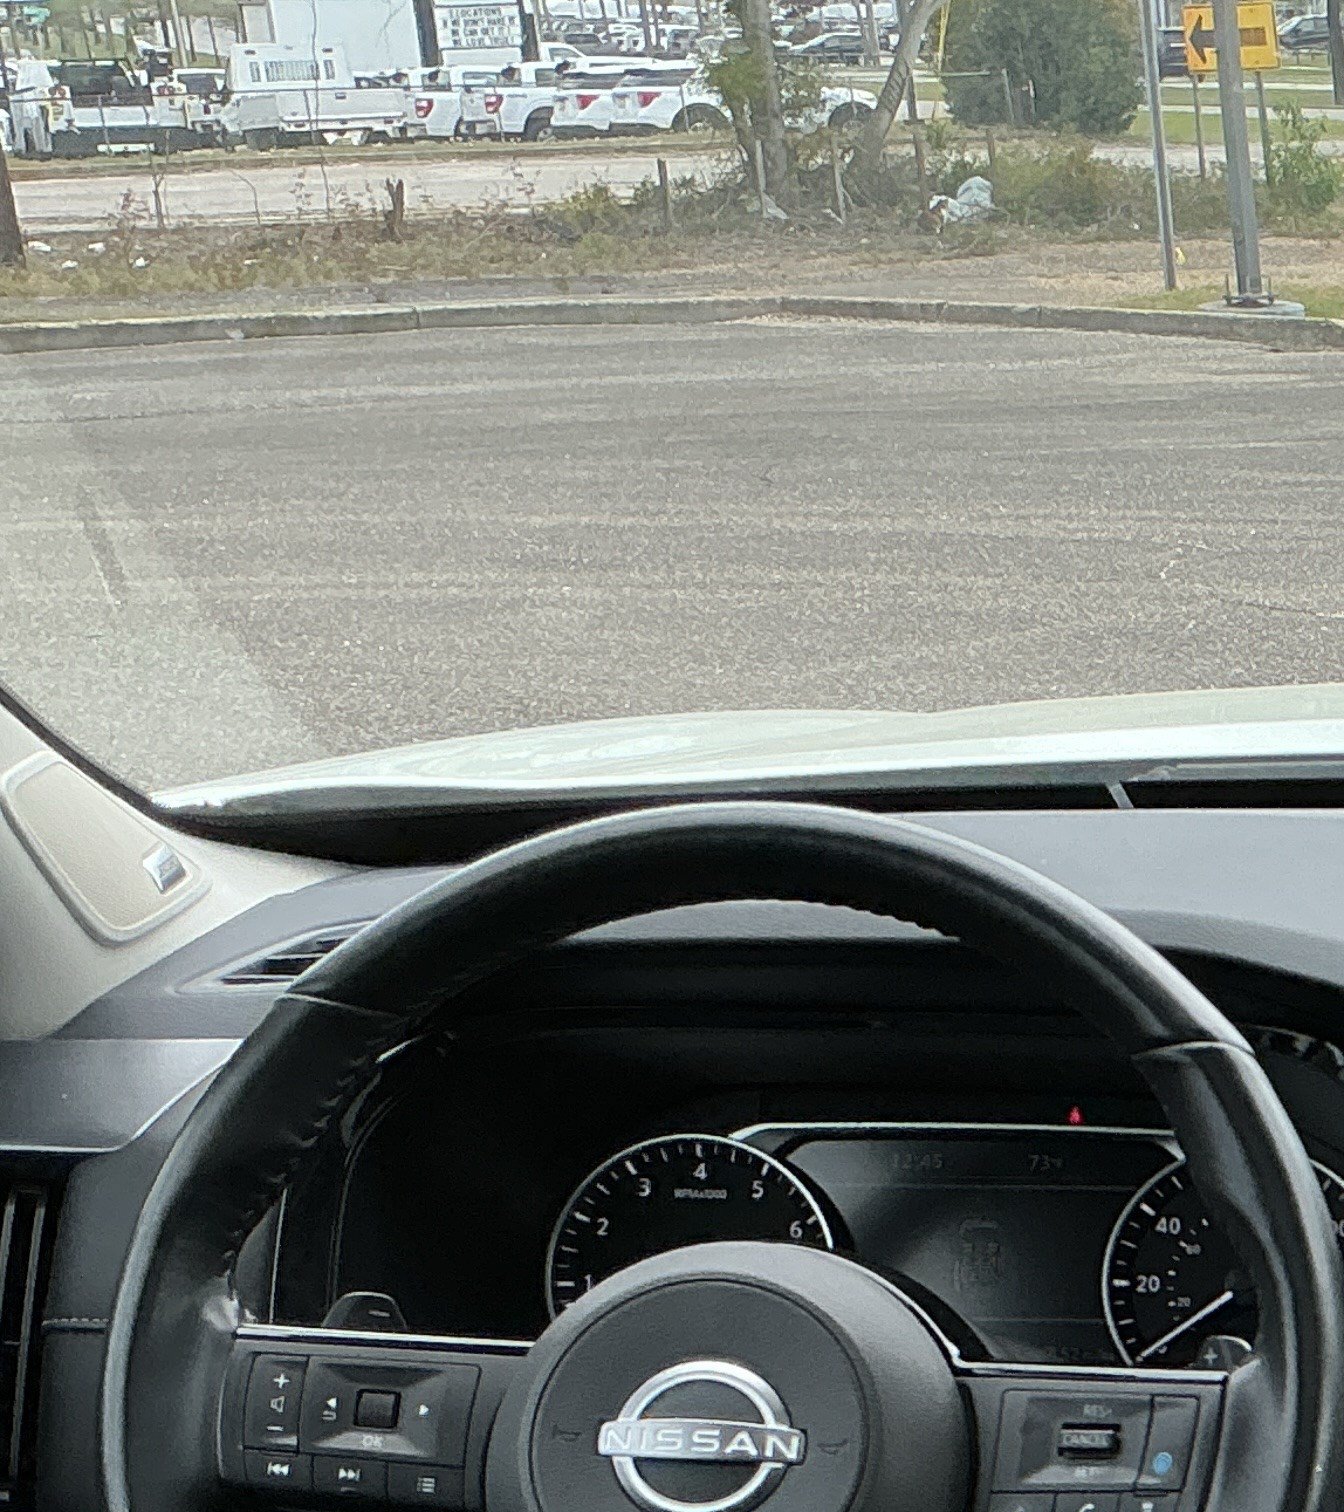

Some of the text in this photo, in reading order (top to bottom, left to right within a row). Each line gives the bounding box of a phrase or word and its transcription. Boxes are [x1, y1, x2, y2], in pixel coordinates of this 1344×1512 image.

[692, 1161, 708, 1180] 4
[638, 1177, 653, 1198] 3
[750, 1179, 764, 1199] 5
[596, 1216, 611, 1237] 2
[790, 1219, 804, 1239] 6
[1153, 1216, 1183, 1236] 40
[1135, 1274, 1161, 1294] 20
[361, 1435, 385, 1449] OK
[605, 1428, 801, 1460] NISSAN
